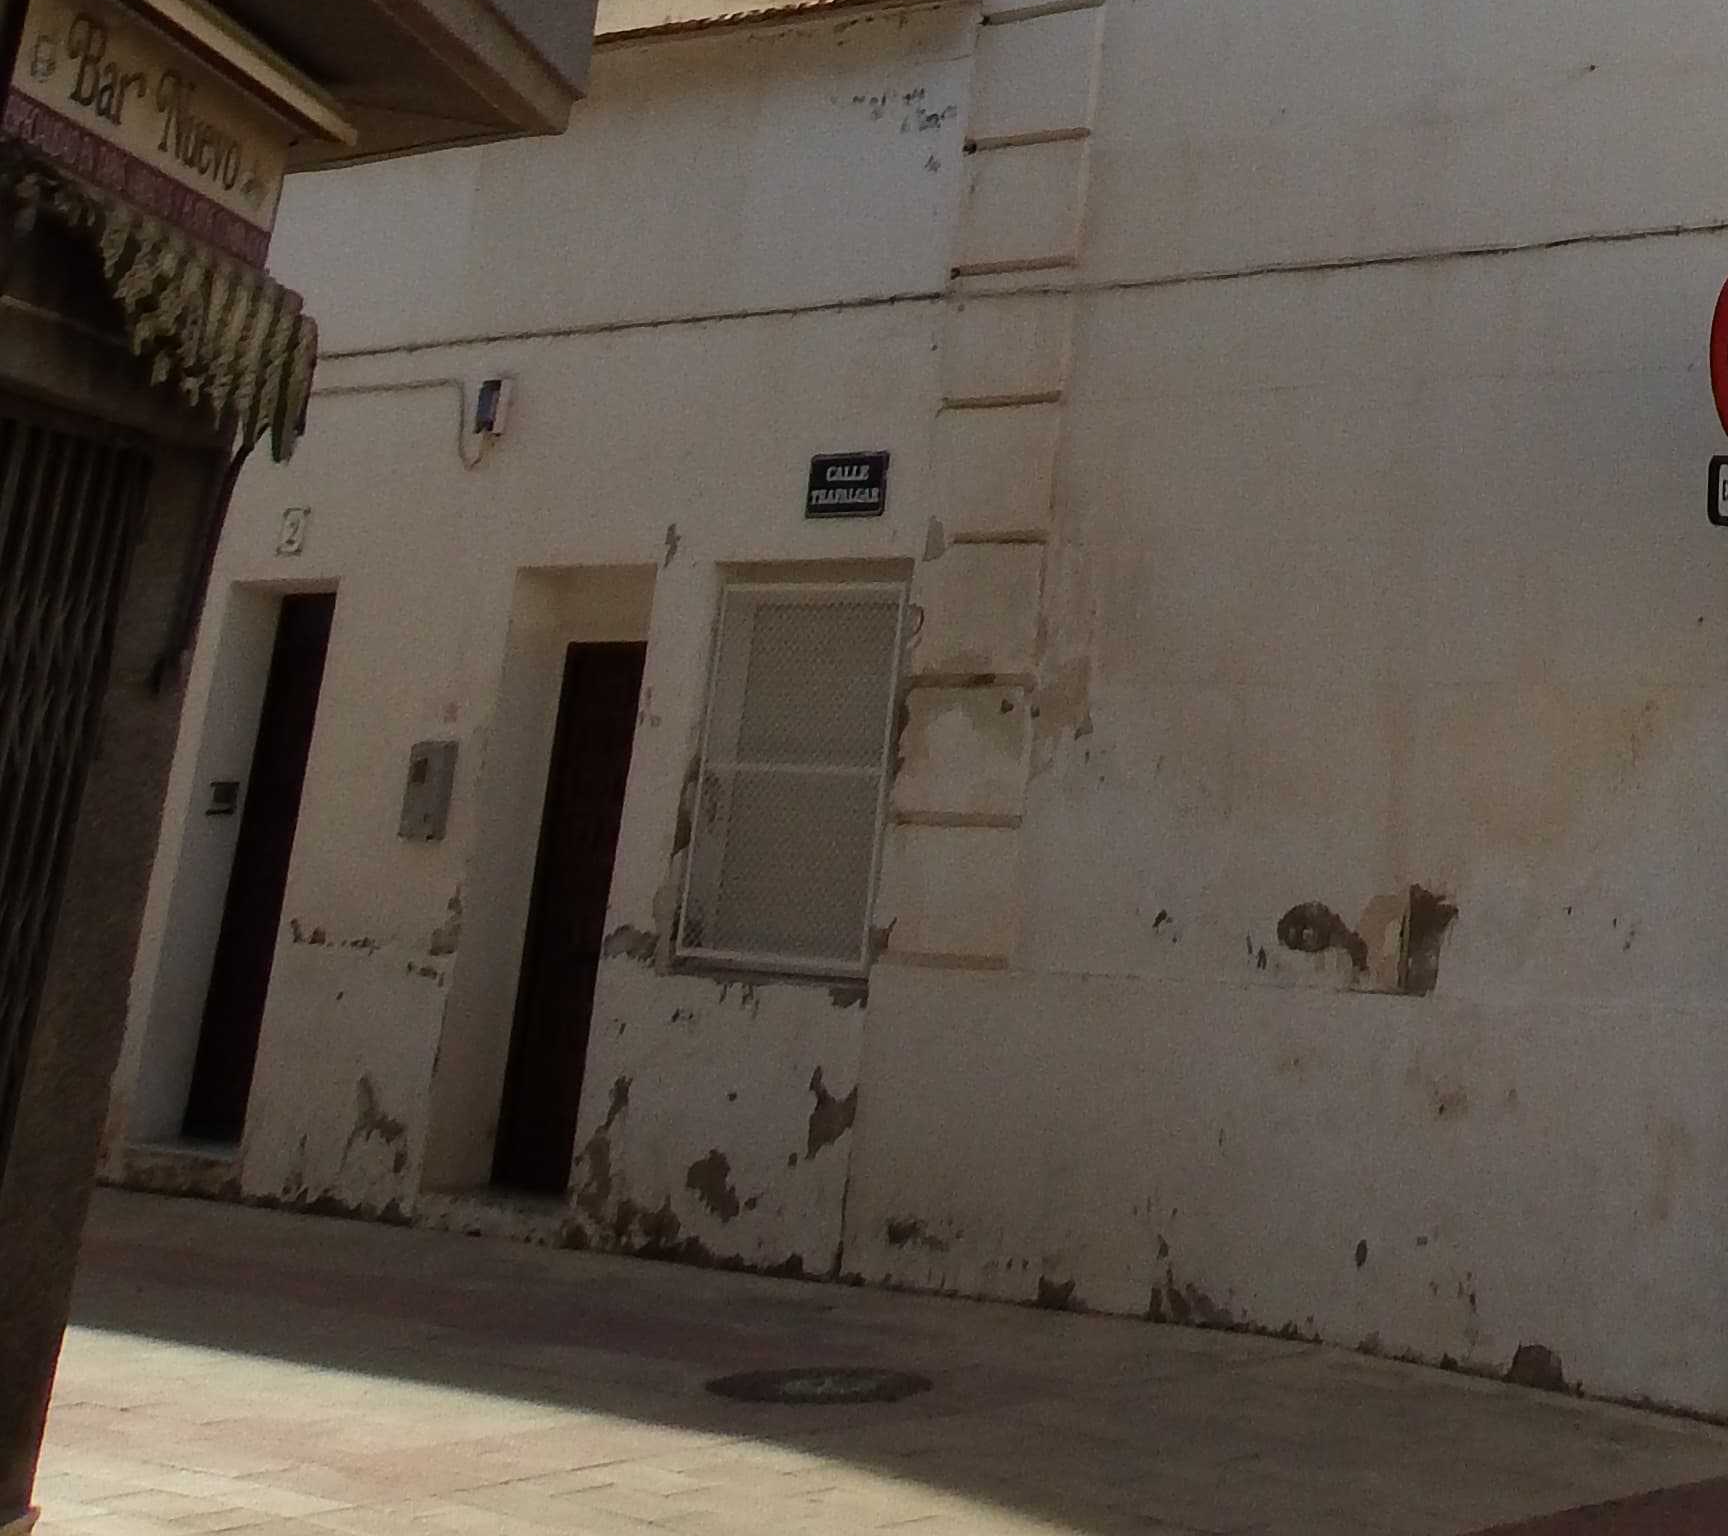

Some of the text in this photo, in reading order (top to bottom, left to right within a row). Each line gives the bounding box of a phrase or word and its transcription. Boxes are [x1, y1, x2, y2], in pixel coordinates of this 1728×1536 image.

[66, 12, 242, 191] Bar Nuevo
[826, 465, 870, 482] CALLE
[811, 488, 880, 505] TRAFALGAR
